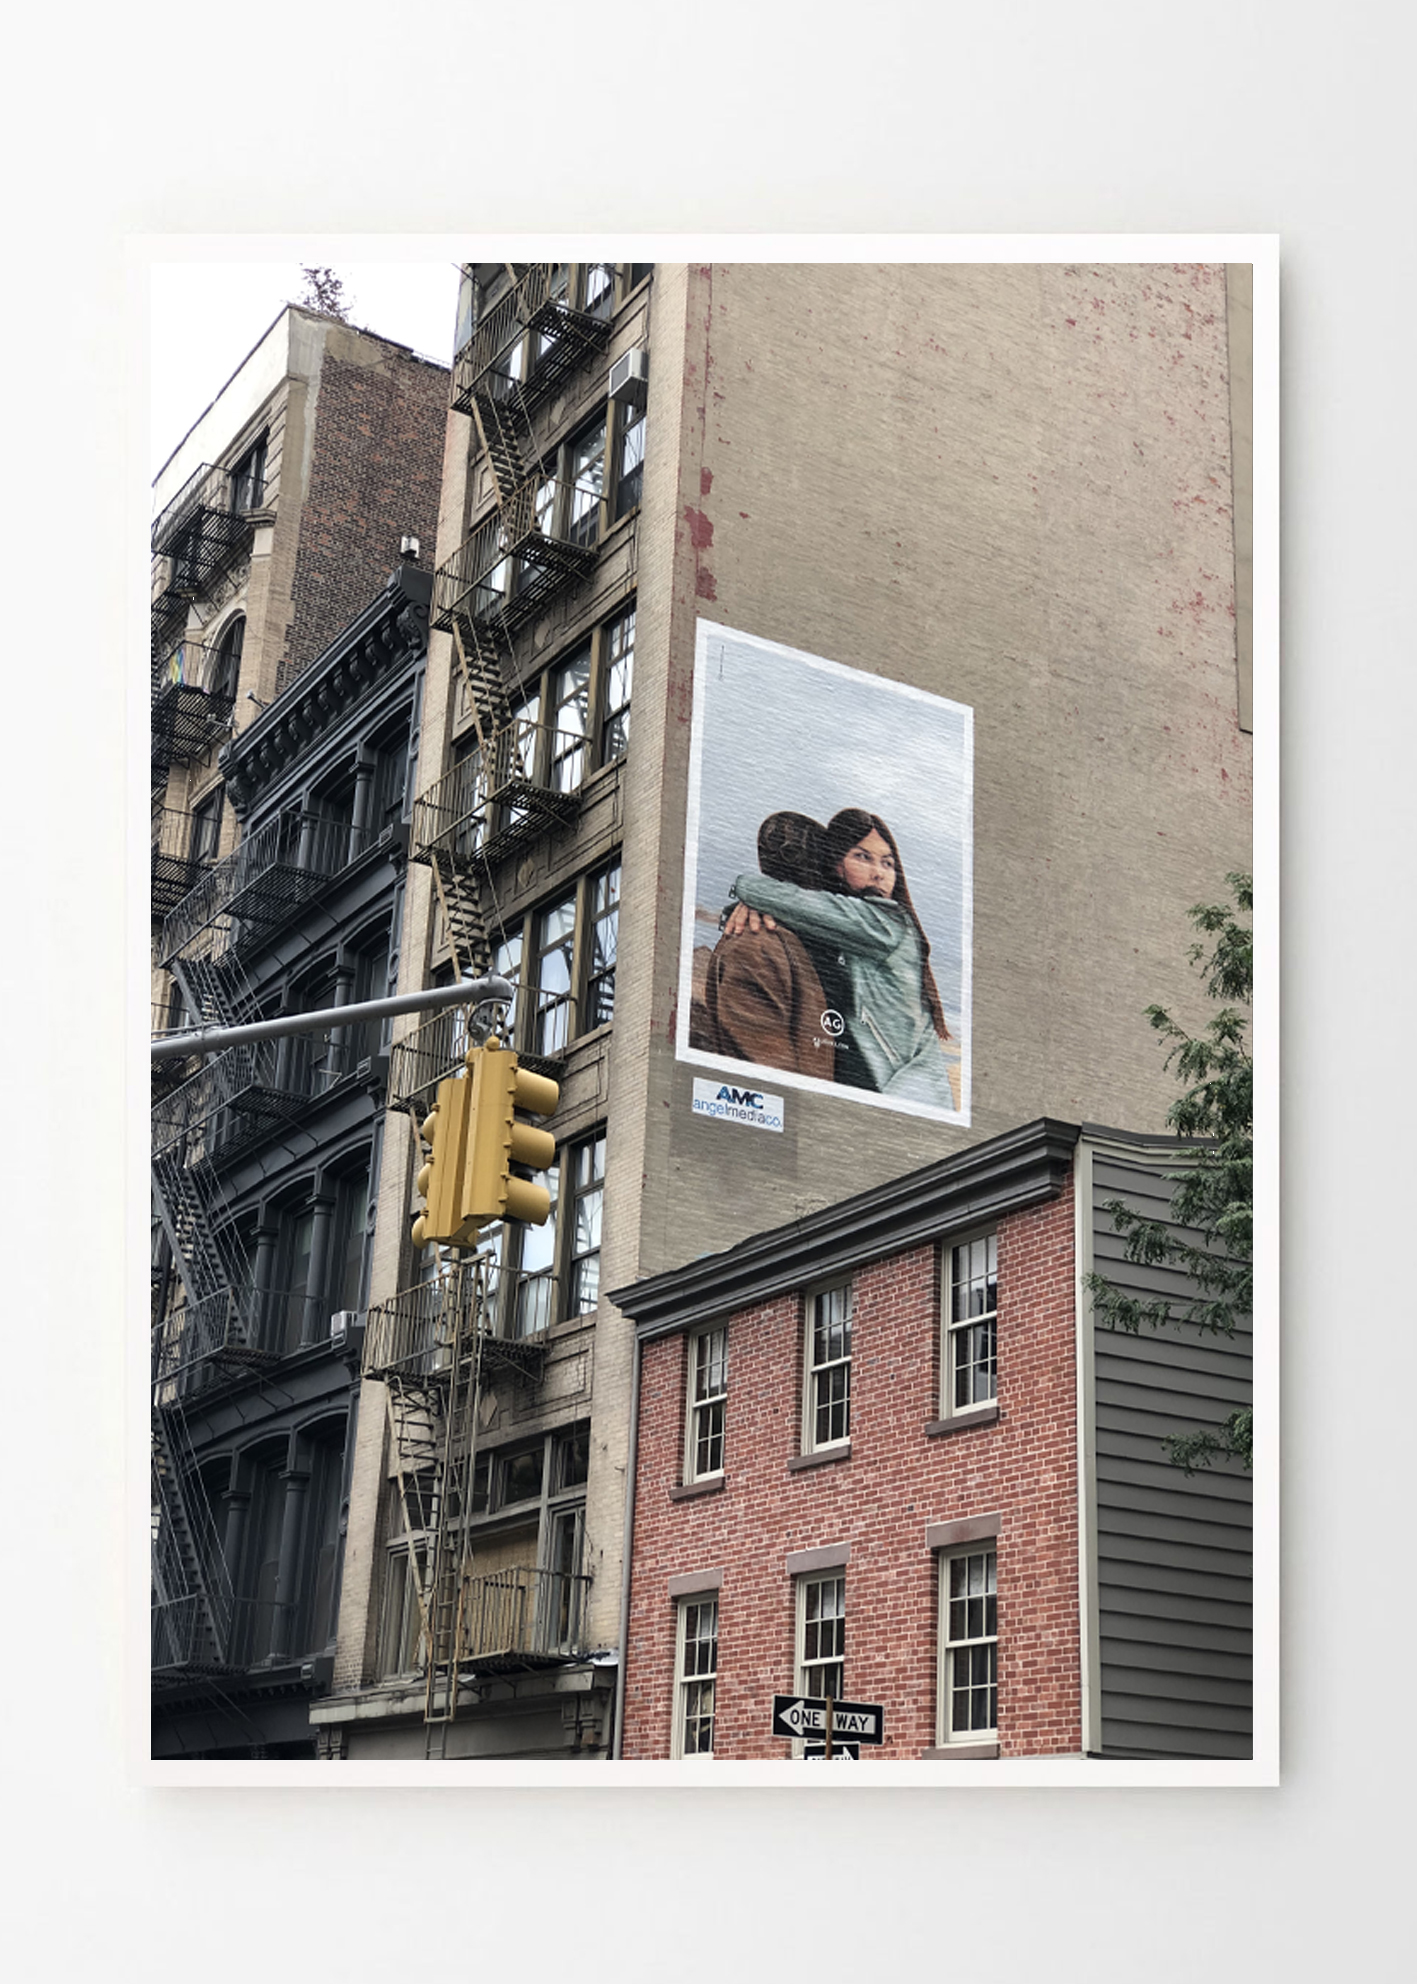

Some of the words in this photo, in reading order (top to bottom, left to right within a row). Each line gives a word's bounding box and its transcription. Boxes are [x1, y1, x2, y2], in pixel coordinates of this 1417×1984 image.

[716, 1086, 764, 1109] AMC
[789, 1709, 821, 1727] ONE
[835, 1713, 869, 1732] WAY
